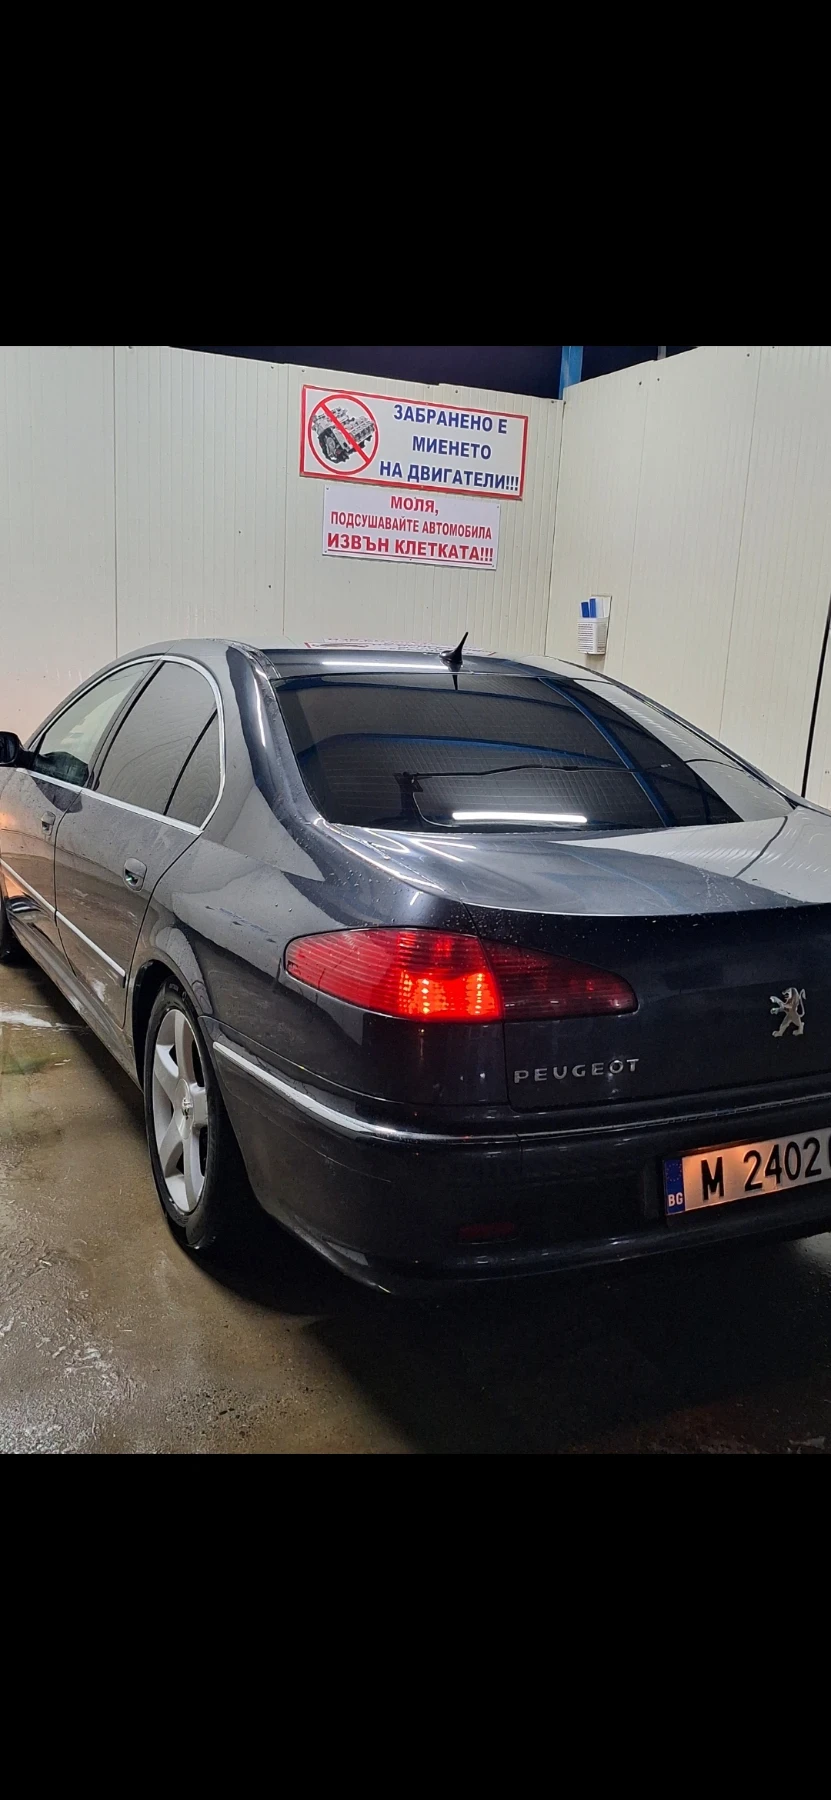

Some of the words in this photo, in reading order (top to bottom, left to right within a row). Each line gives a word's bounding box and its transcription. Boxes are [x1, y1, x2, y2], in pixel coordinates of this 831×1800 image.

[393, 404, 493, 432] ЗАБРАНЕНО
[498, 418, 508, 434] Е
[412, 435, 492, 460] МИЕНЕТО
[379, 461, 401, 478] НА
[407, 464, 519, 491] ДВИГАТЕЛИ!!!
[390, 495, 439, 516] МОЛЯ,
[330, 511, 419, 533] ПОДСУШАВАЙТЕ
[422, 521, 492, 540] АВТОМОБИЛА
[327, 532, 389, 551] ИЗВЪН
[394, 539, 494, 562] КЛЕТКАТА!!!
[513, 1058, 640, 1083] PEUGEOT
[700, 1156, 725, 1201] M
[667, 1192, 684, 1208] BG
